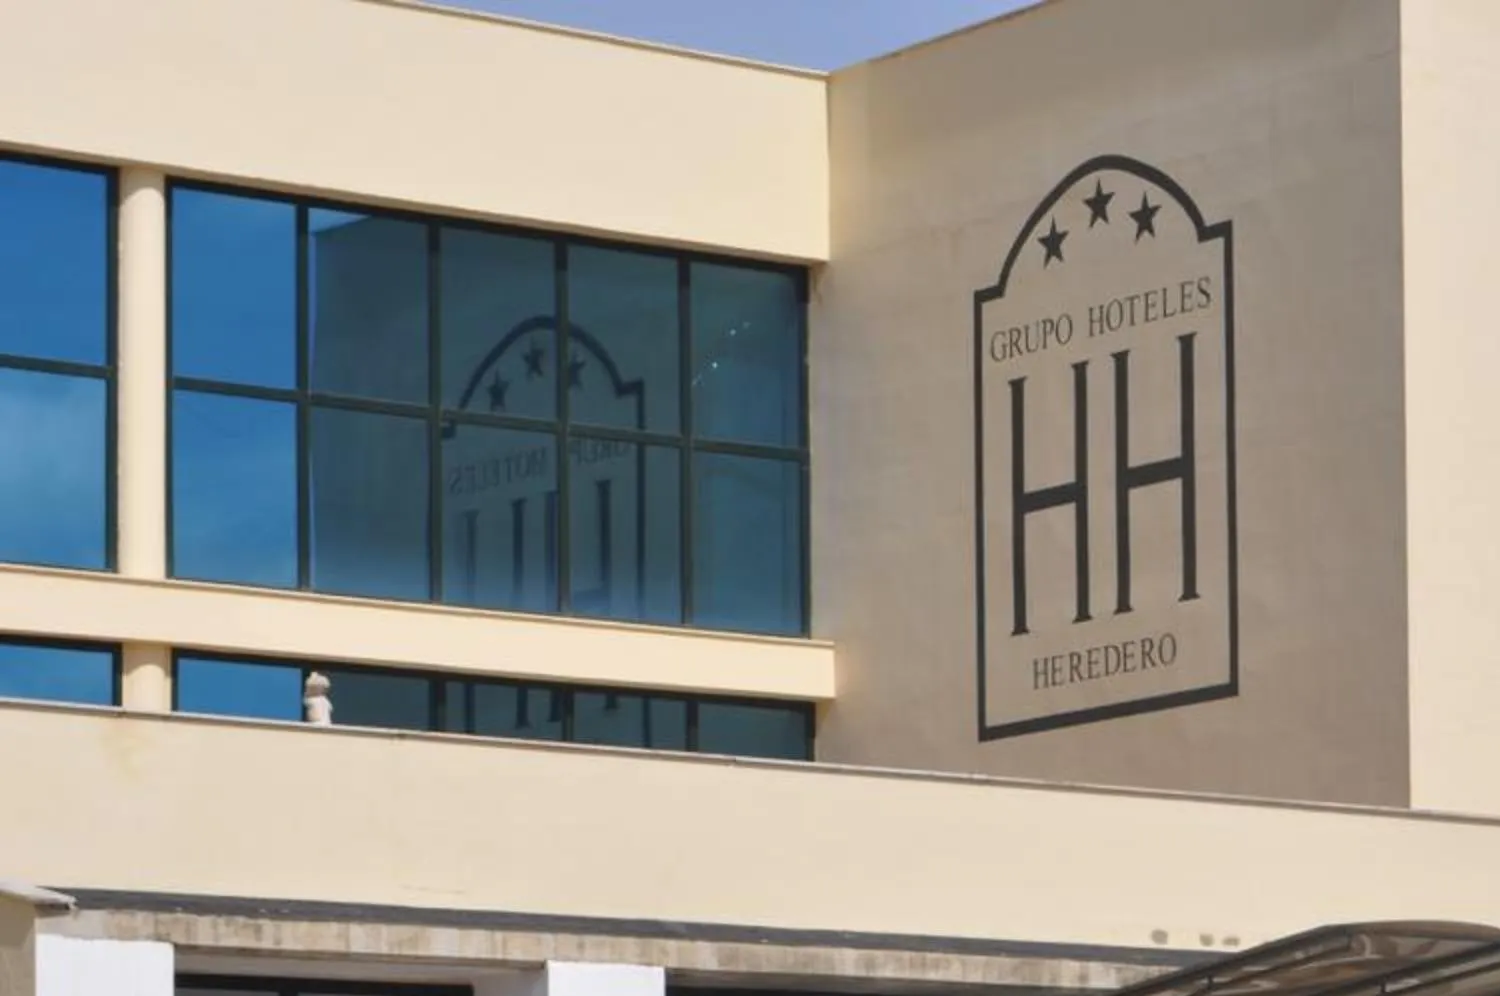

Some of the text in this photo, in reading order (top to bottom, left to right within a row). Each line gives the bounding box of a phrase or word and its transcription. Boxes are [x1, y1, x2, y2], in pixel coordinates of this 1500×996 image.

[989, 275, 1213, 364] GRUPO HOTELES
[1032, 631, 1178, 691] HEREDERO
